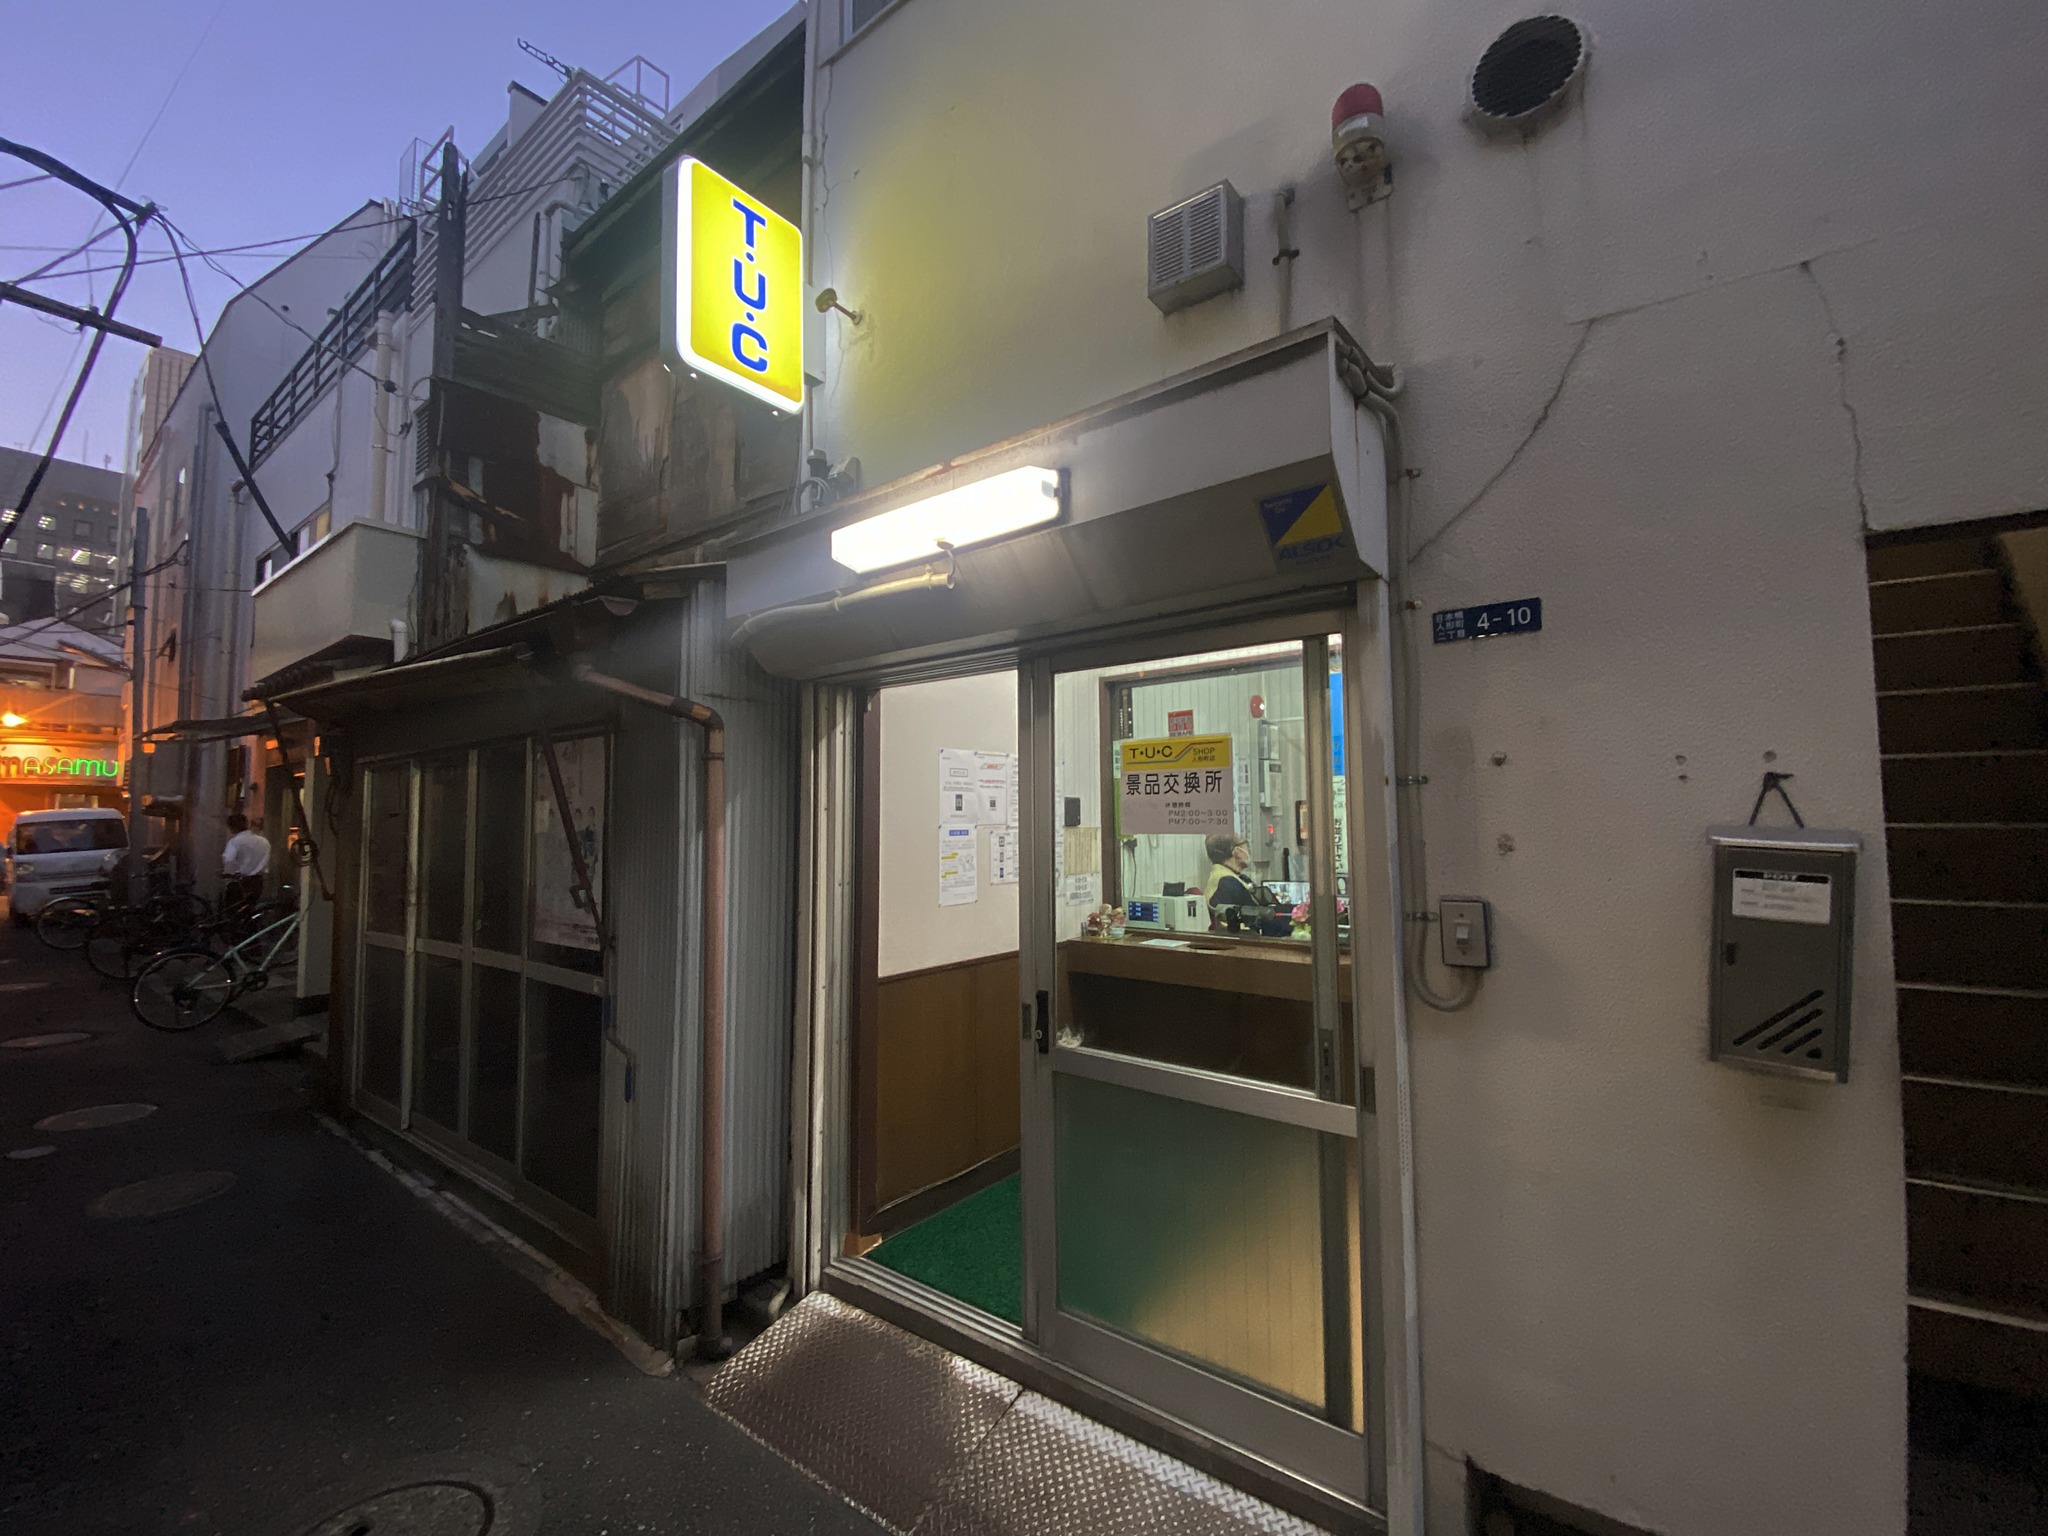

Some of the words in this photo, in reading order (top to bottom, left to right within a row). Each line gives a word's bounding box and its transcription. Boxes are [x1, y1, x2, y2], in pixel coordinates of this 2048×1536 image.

[1436, 611, 1464, 624] 日本橋
[1477, 607, 1531, 630] 4-10
[1436, 620, 1464, 632] 人形町
[1193, 747, 1215, 756] SHOP
[1126, 770, 1222, 796] 景品交換所
